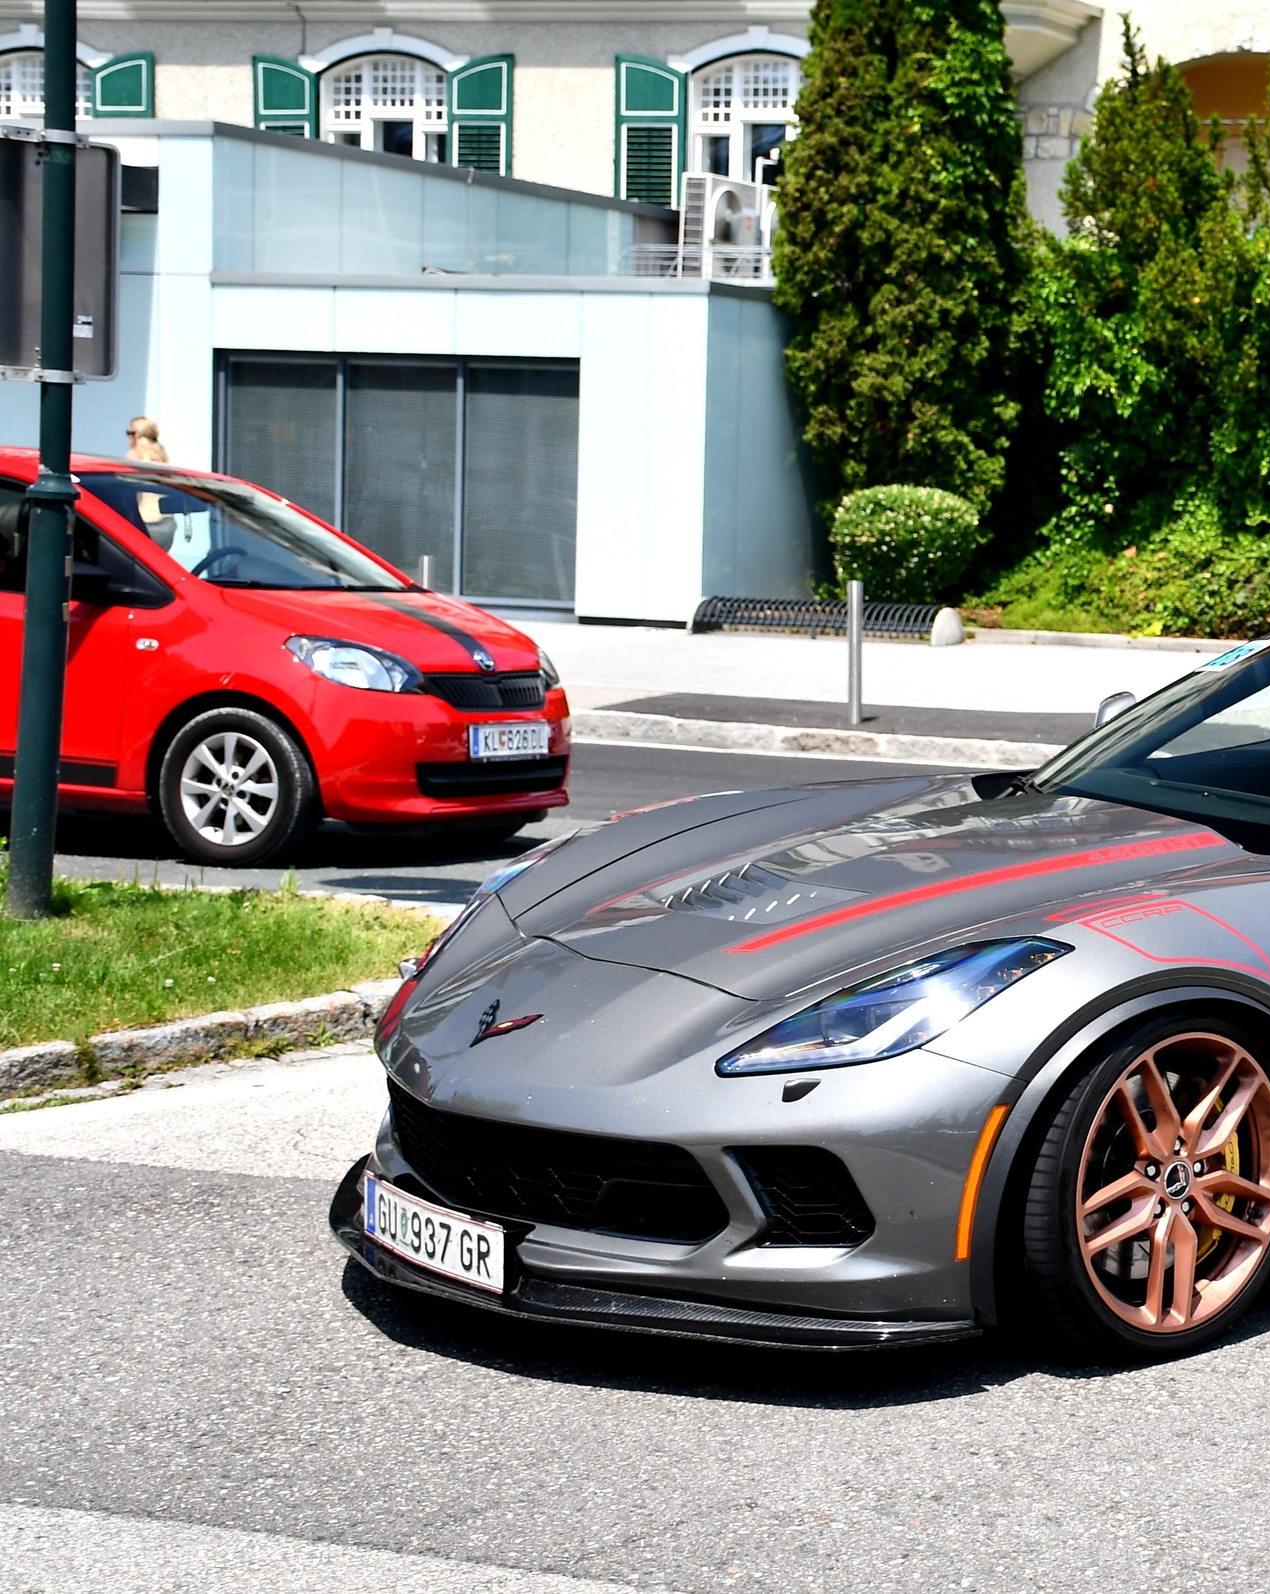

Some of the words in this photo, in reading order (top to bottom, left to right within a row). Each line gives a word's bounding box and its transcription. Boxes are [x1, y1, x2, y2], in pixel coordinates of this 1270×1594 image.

[484, 731, 498, 752] KL
[1101, 905, 1182, 928] CCRP
[378, 1193, 398, 1240] GU
[411, 1211, 452, 1263] 937
[460, 1229, 491, 1280] GR
